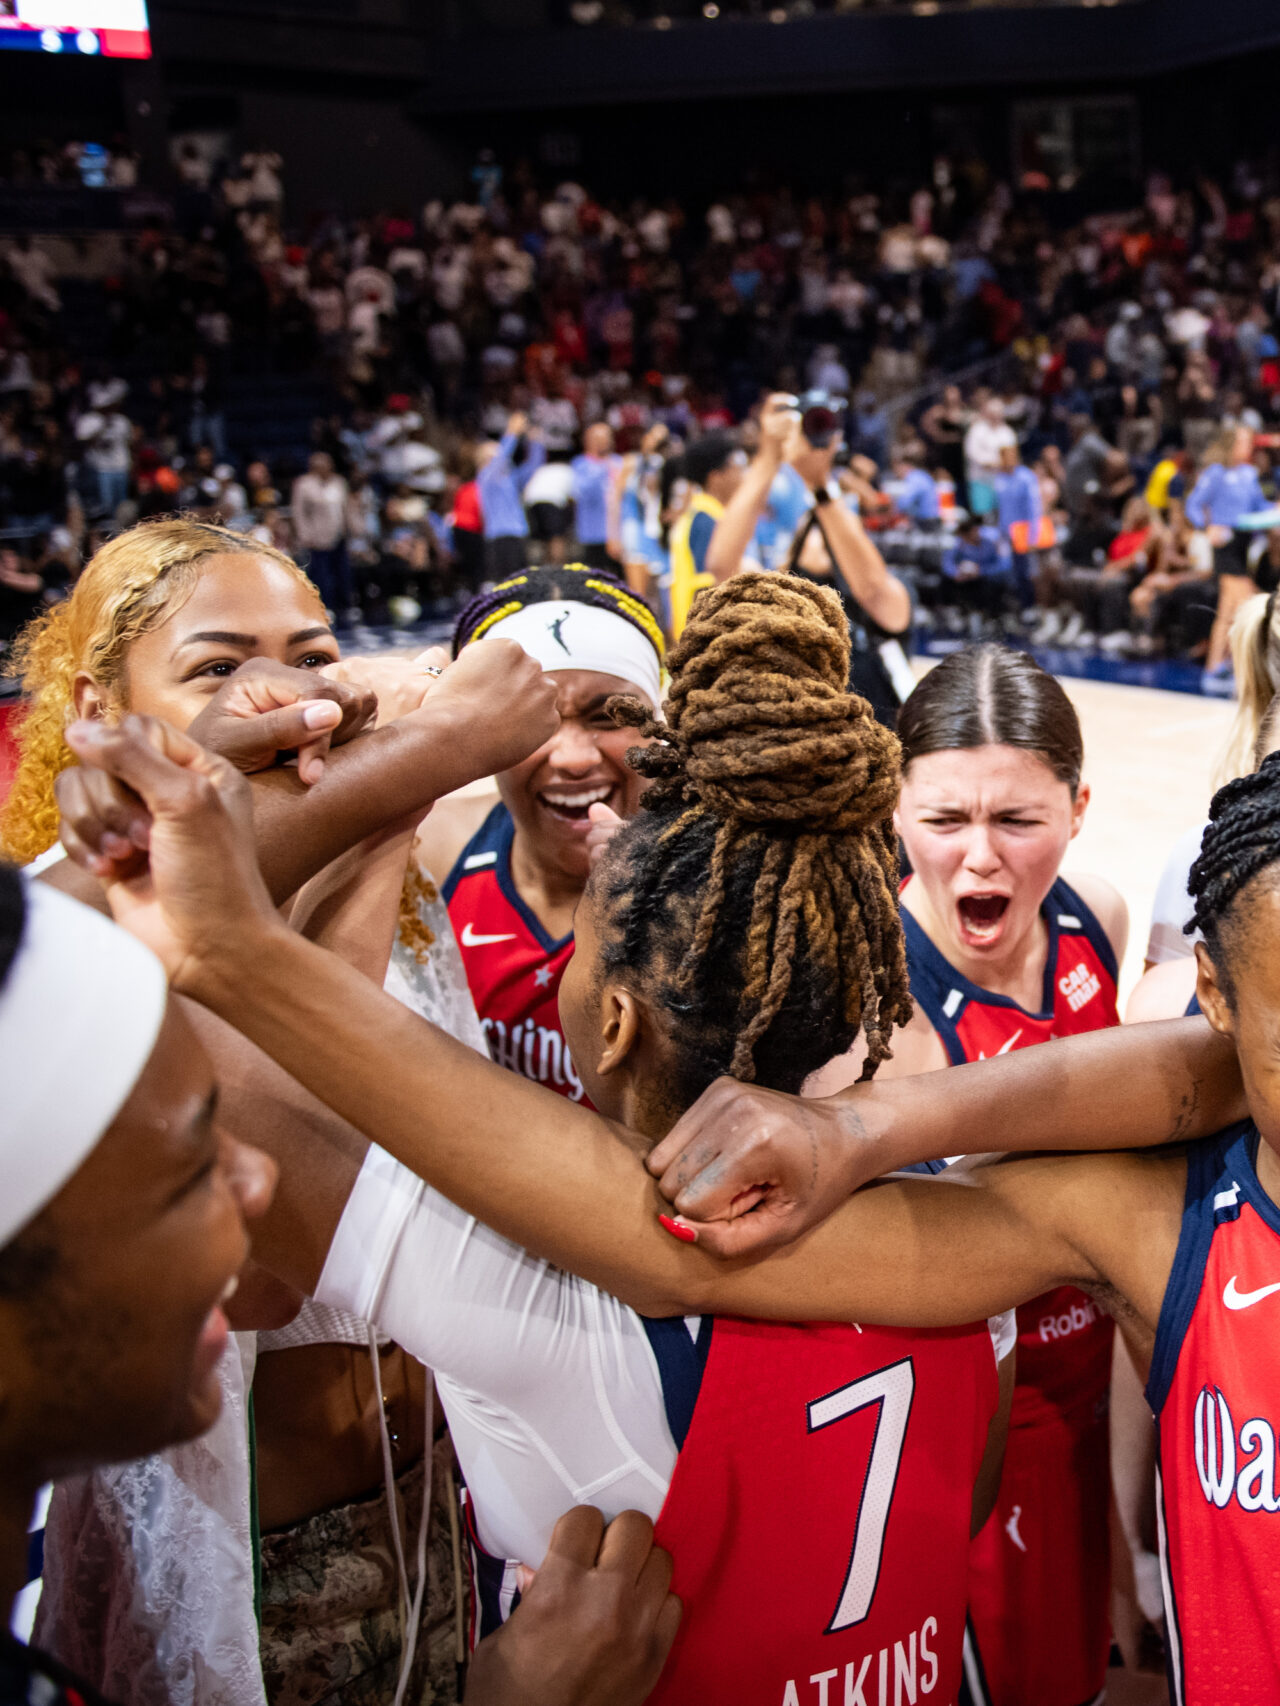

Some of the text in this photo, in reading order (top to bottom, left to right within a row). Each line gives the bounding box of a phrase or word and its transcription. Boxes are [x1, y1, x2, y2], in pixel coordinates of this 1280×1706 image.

[1059, 963, 1090, 995] CAR
[1067, 973, 1101, 1012] max
[805, 1355, 915, 1635] 7
